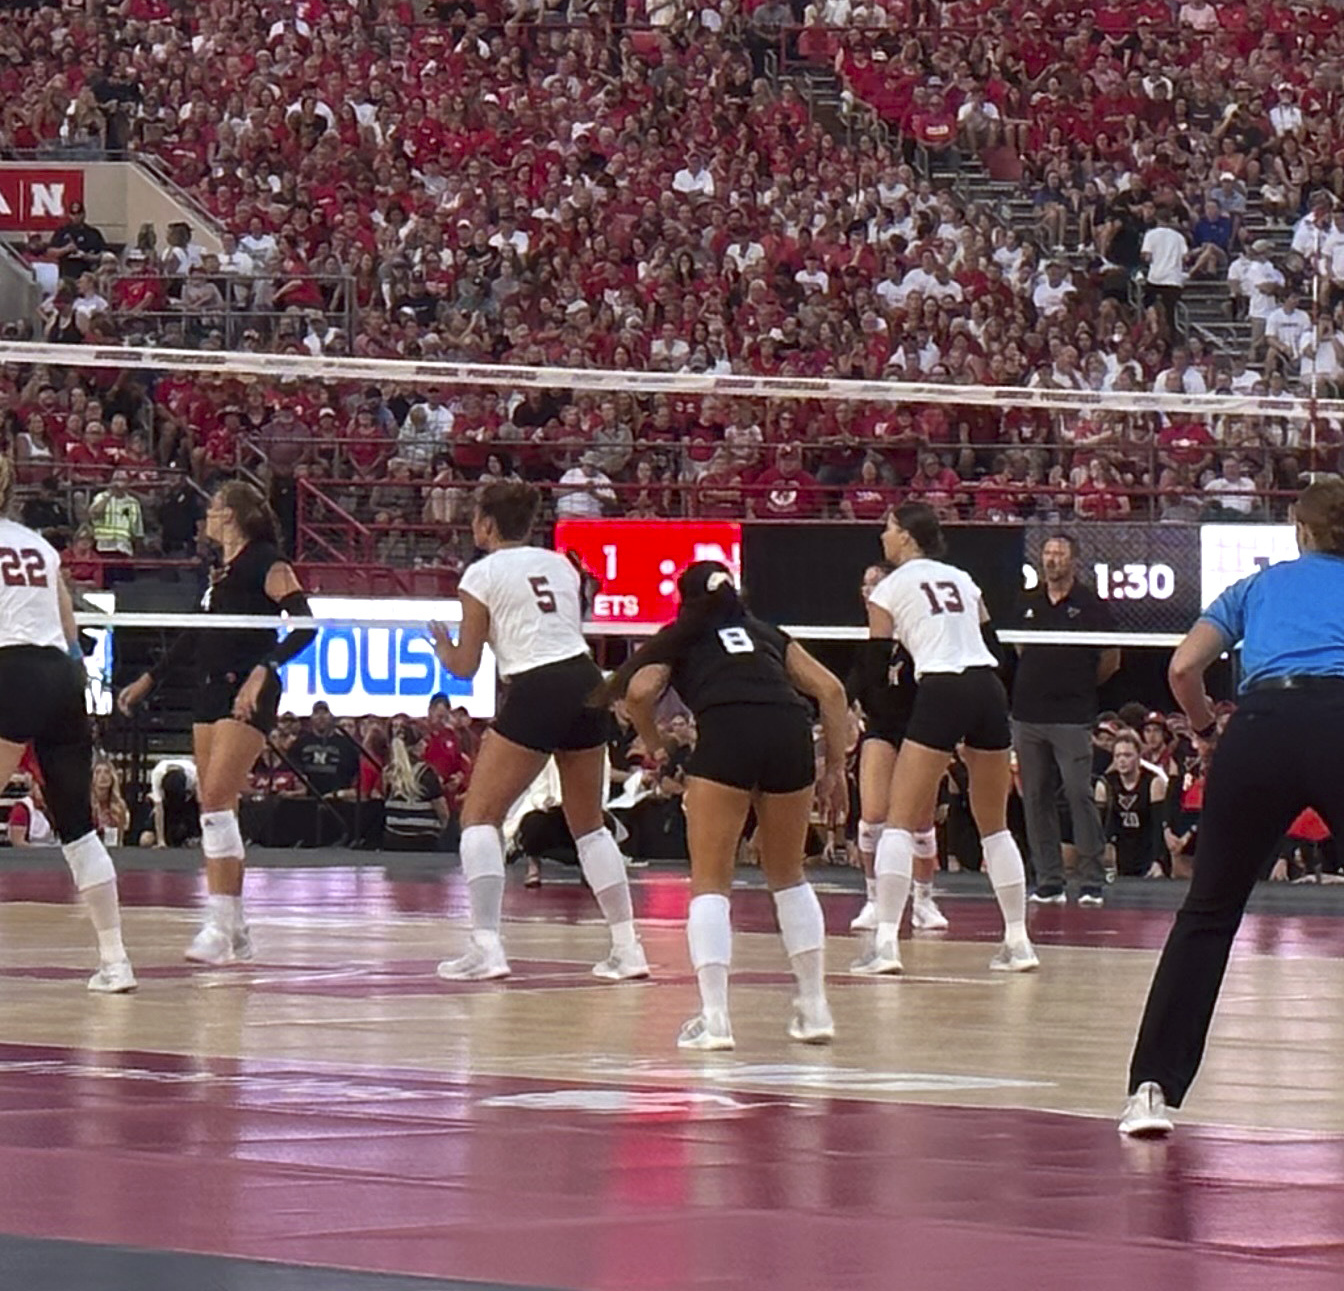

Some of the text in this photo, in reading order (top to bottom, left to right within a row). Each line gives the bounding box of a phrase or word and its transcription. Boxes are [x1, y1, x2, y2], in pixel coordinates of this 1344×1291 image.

[30, 183, 65, 216] N
[602, 544, 618, 581] 1
[528, 575, 557, 614] 5
[919, 580, 965, 616] 13
[1094, 563, 1176, 601] 1:30
[593, 594, 640, 617] ETS
[716, 626, 755, 655] 8
